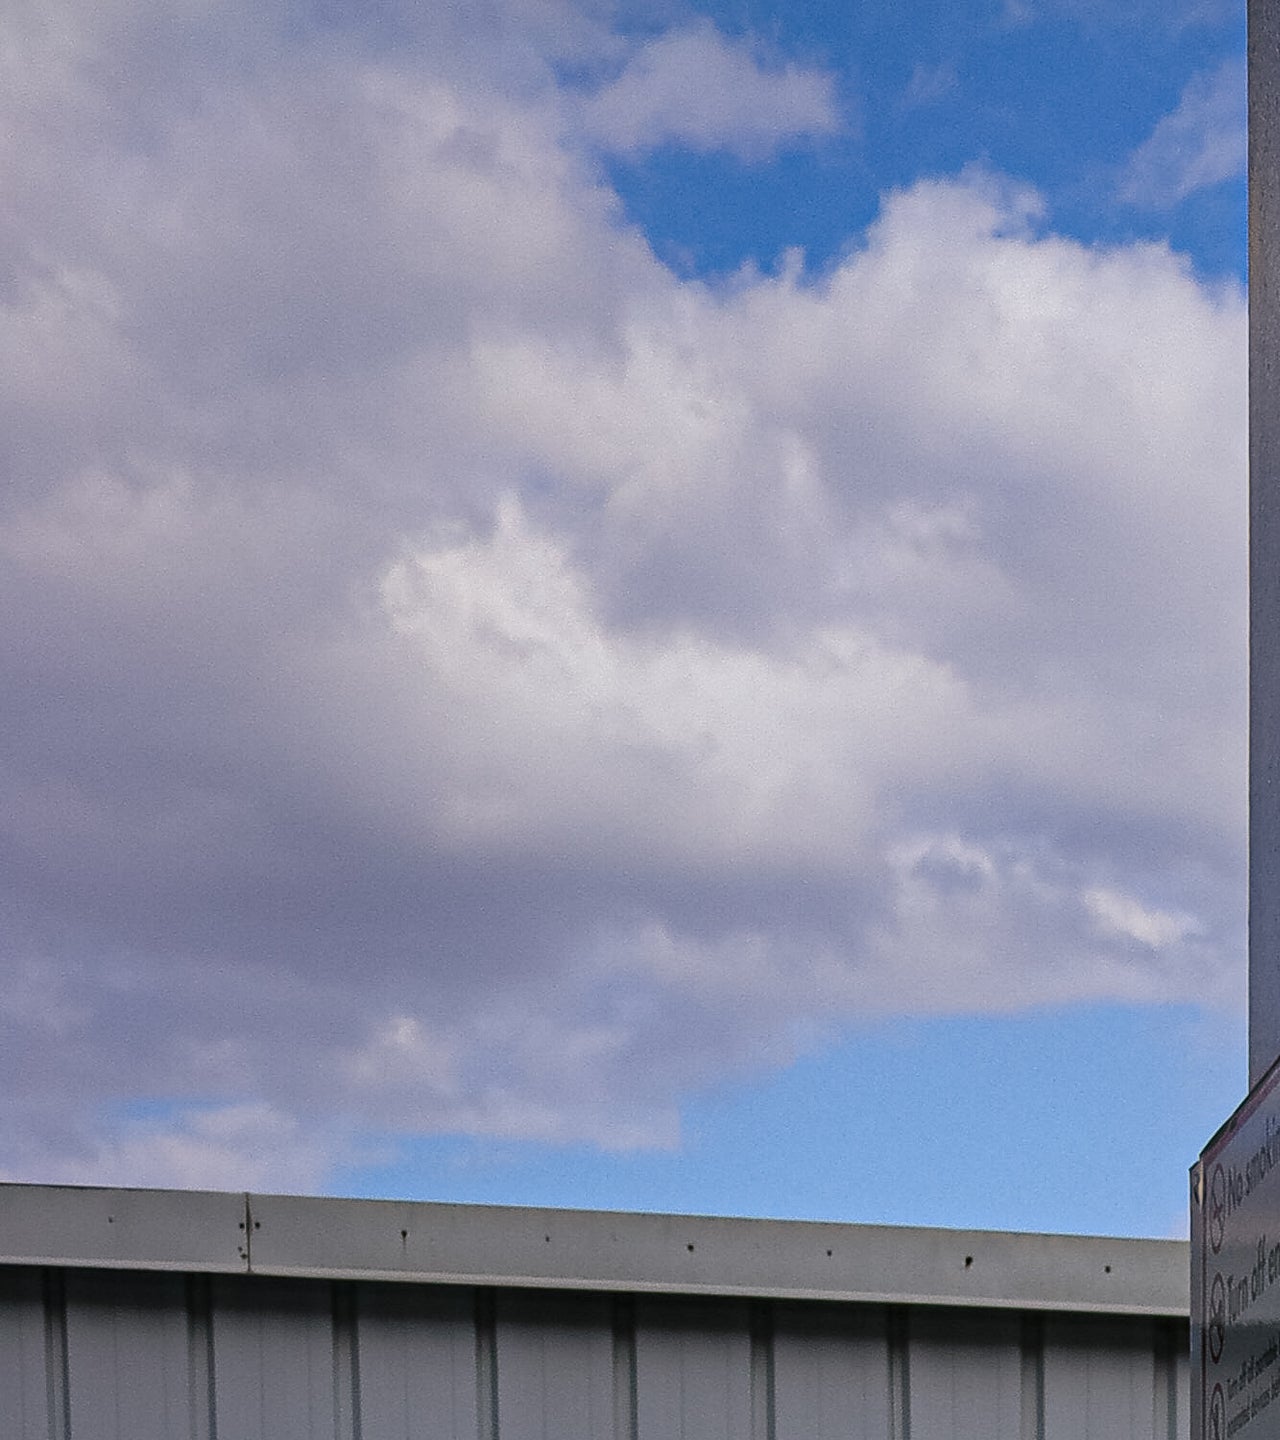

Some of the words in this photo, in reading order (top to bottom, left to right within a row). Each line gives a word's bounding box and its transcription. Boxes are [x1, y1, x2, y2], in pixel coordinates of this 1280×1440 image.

[1228, 1164, 1243, 1216] No
[1228, 1274, 1248, 1325] Turn
[1251, 1233, 1266, 1303] off
